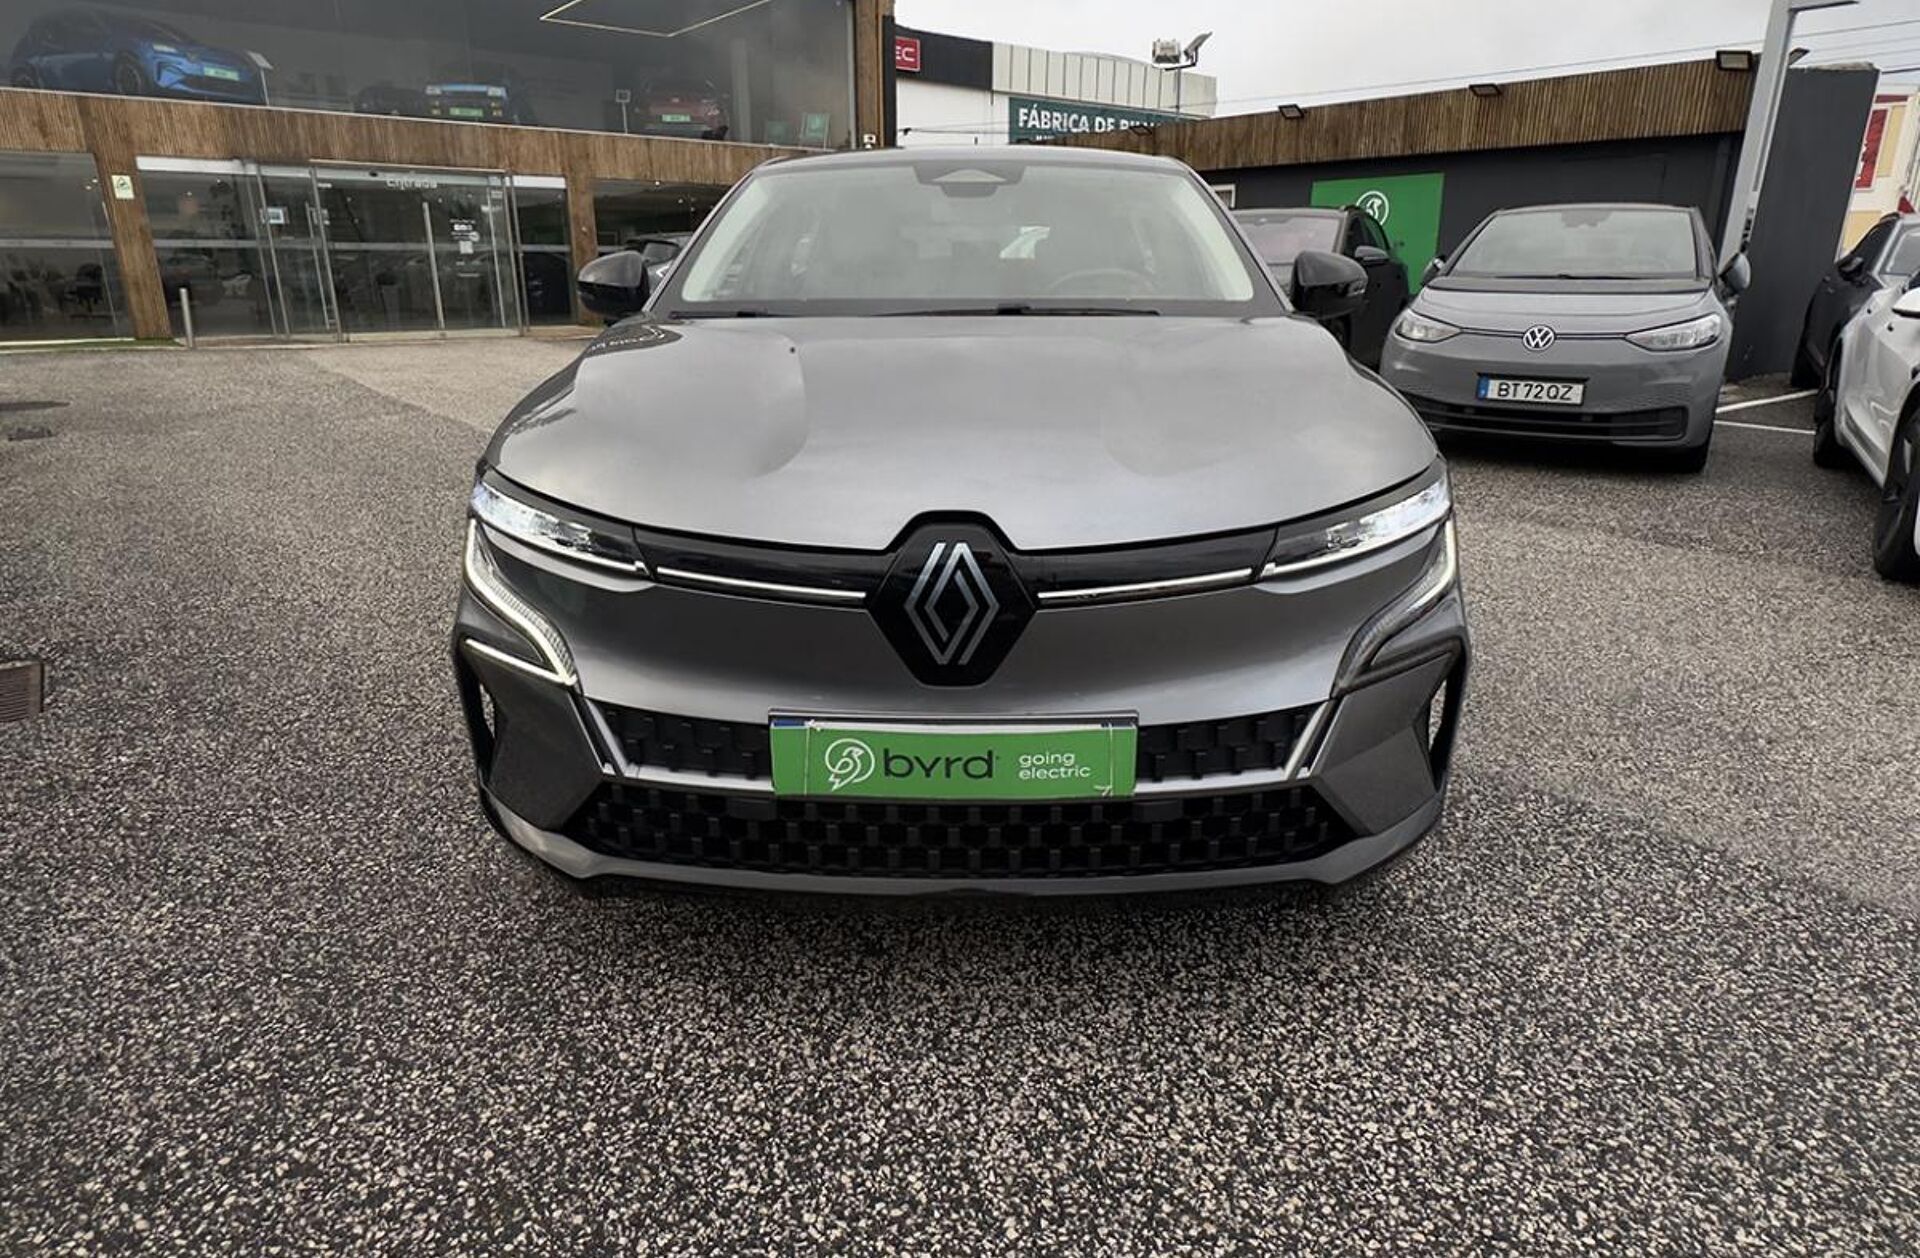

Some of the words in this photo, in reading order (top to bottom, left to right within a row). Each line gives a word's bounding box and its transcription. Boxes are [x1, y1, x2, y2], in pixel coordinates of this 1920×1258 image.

[1018, 103, 1090, 133] FÁBRICA
[884, 748, 993, 779] byrd
[1018, 752, 1075, 767] going
[1018, 765, 1091, 780] electric
